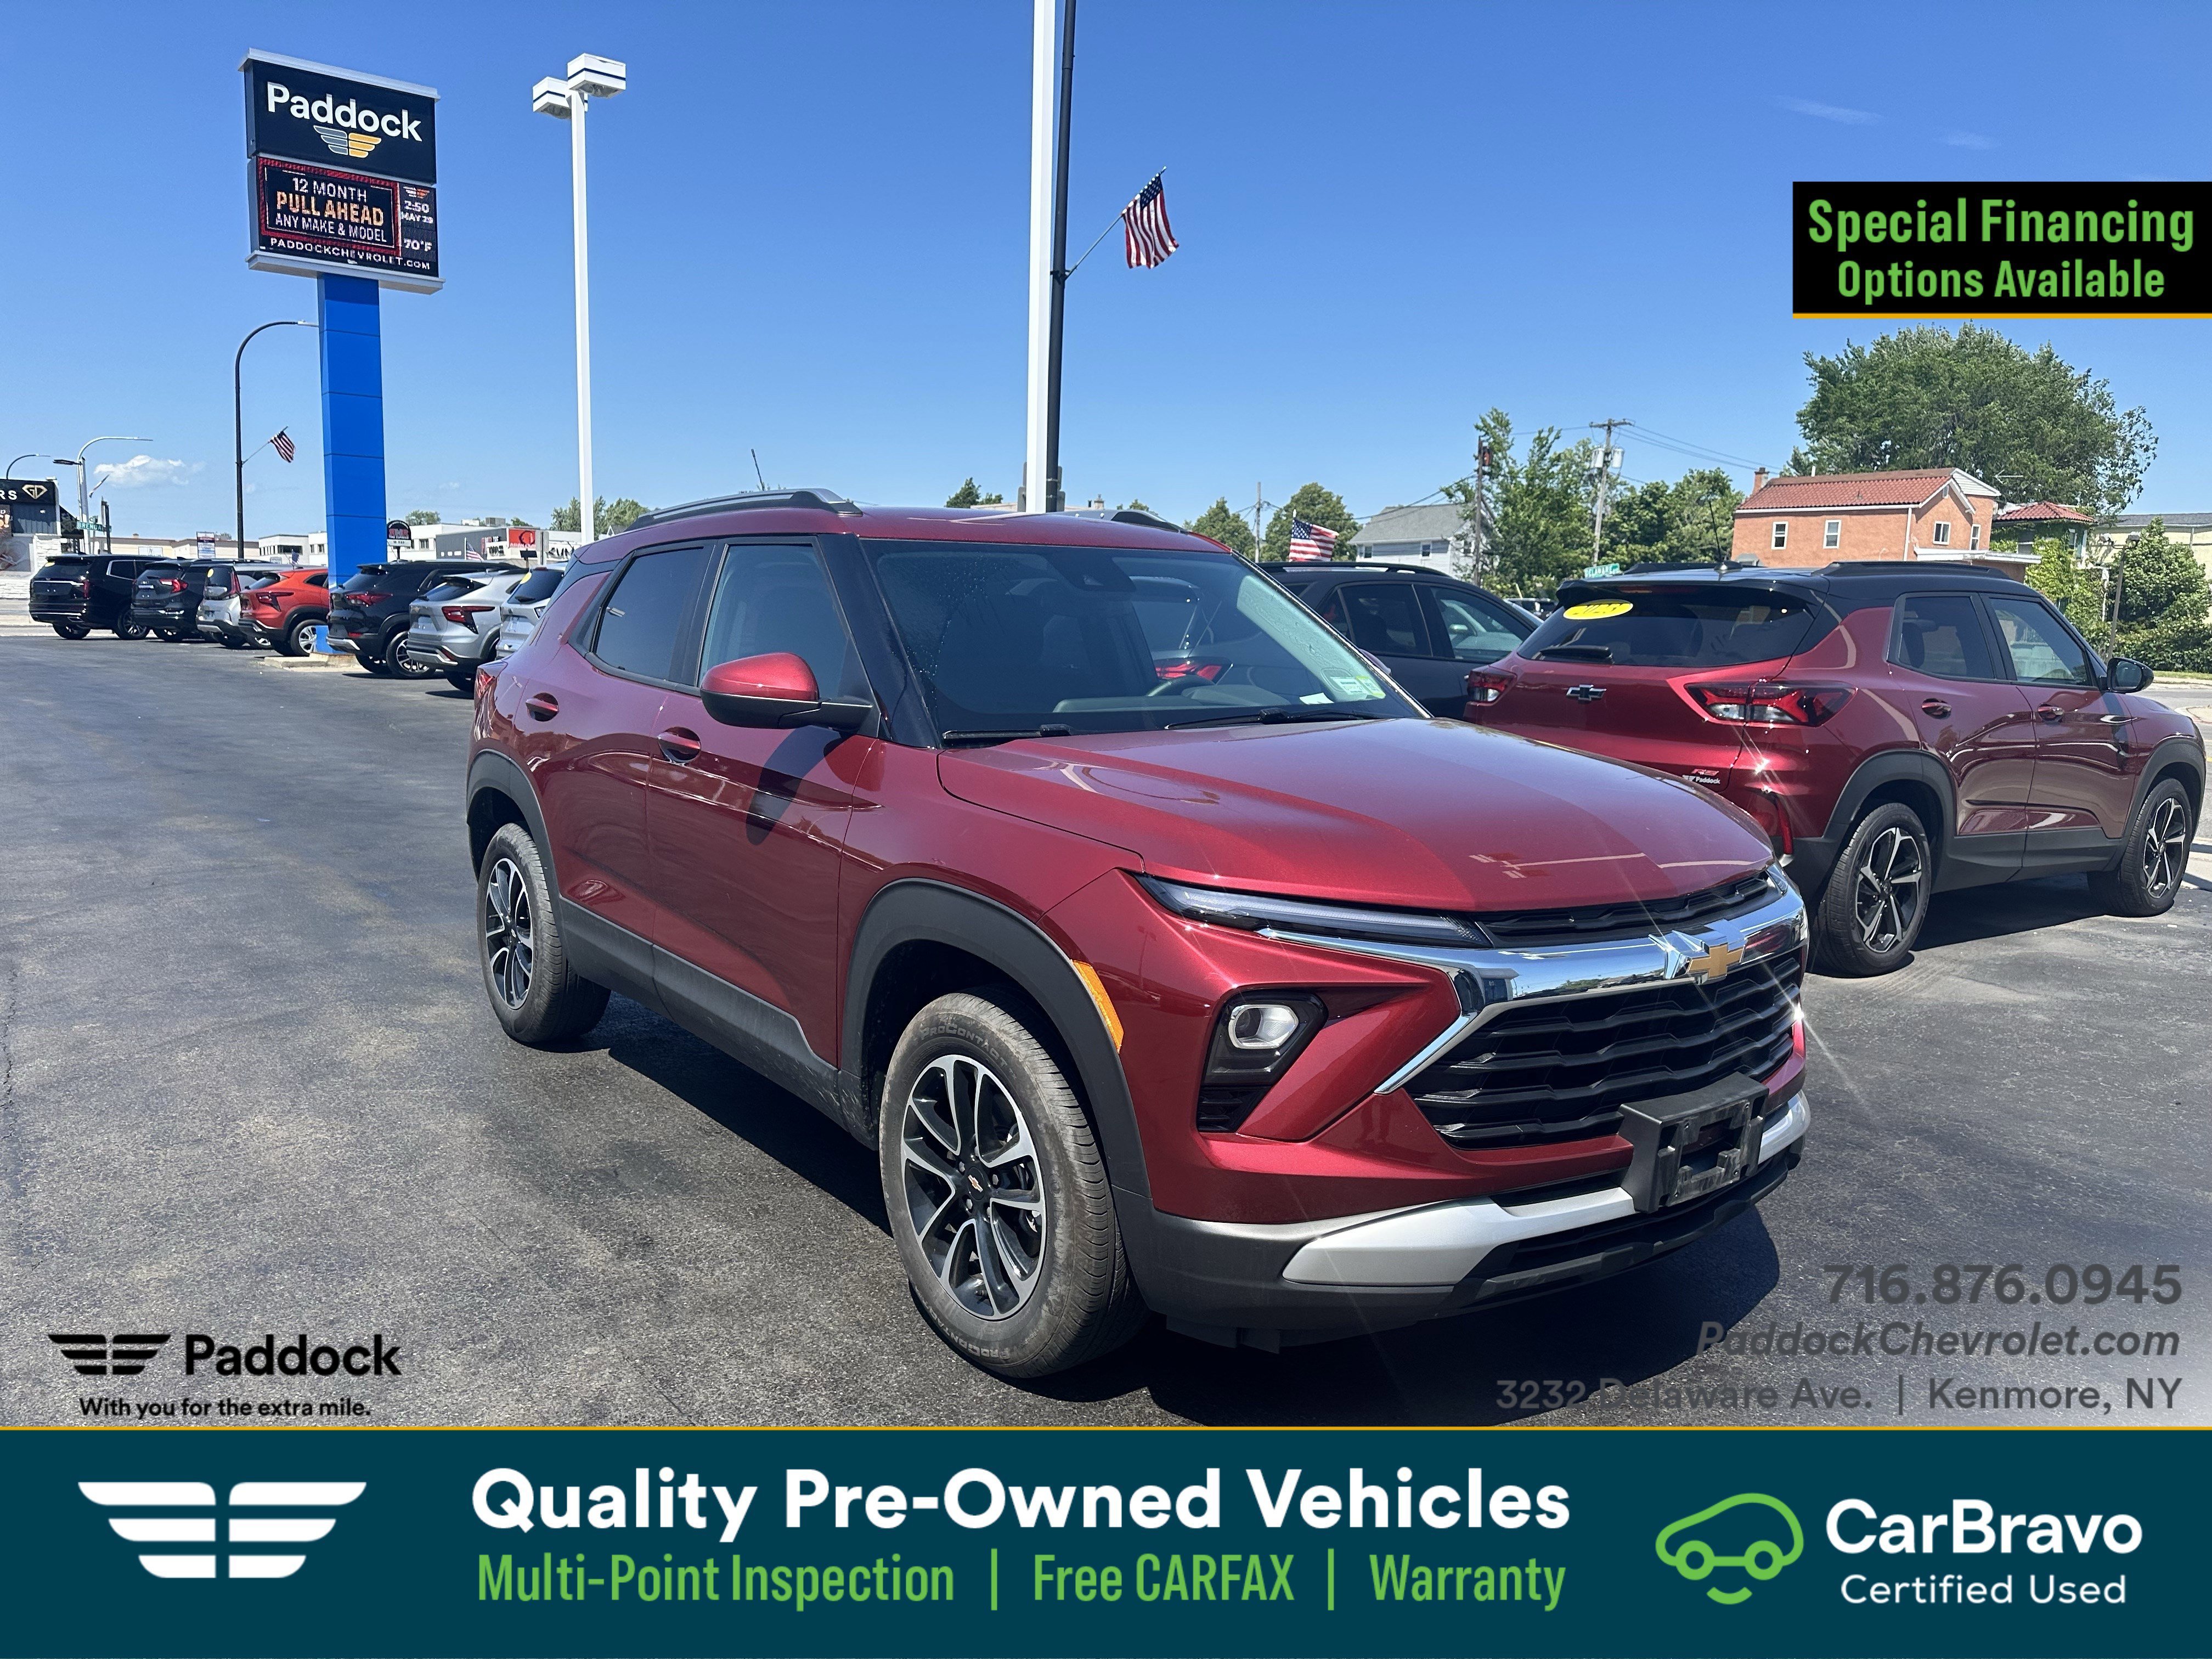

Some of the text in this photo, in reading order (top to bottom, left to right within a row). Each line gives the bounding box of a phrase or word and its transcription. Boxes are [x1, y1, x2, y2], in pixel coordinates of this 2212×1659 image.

[267, 82, 422, 142] Paddock
[292, 177, 367, 202] 12 MONTH
[276, 191, 384, 226] PULL AHEAD
[401, 212, 421, 222] MAY
[275, 213, 387, 242] ANY MAKE & MODEL
[271, 238, 430, 270] PADDOCKCHEVROLET.COM
